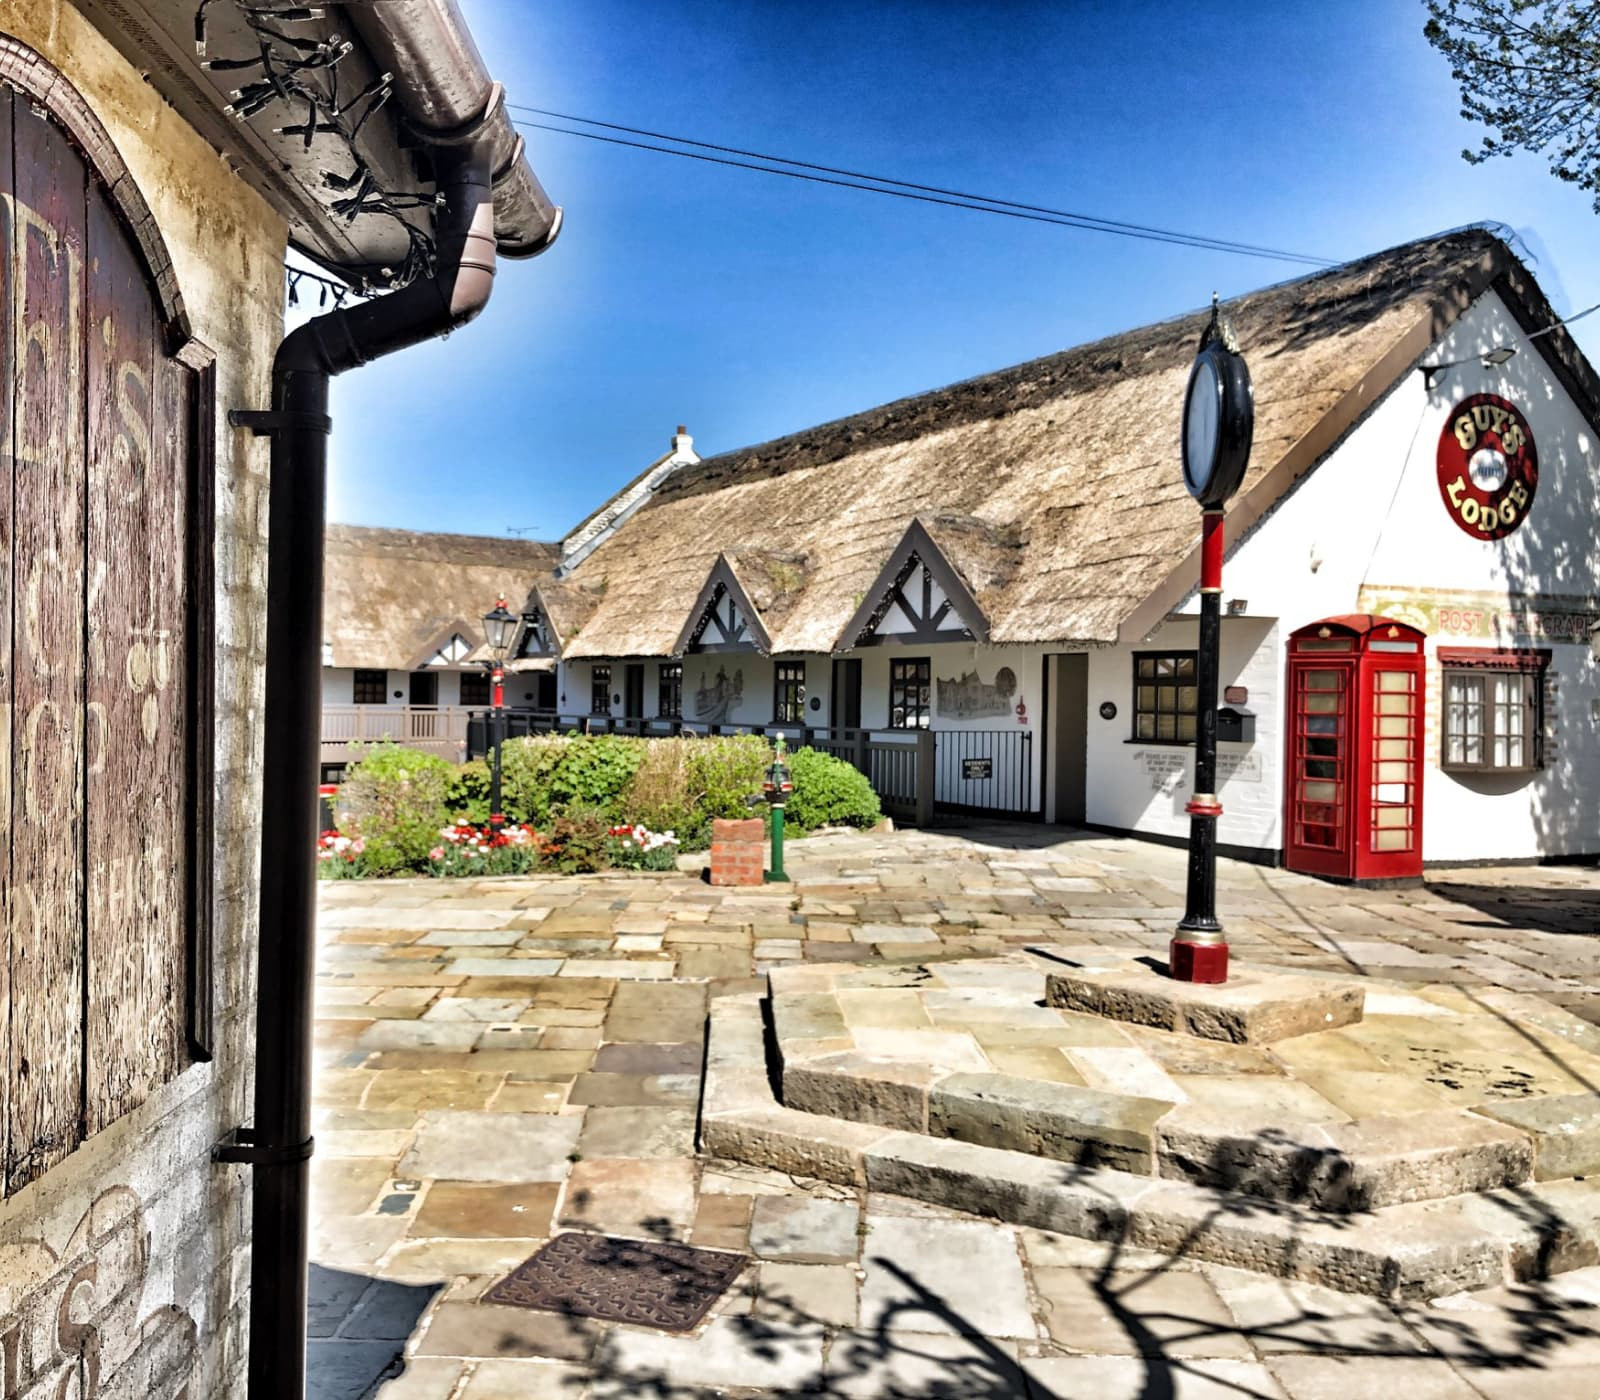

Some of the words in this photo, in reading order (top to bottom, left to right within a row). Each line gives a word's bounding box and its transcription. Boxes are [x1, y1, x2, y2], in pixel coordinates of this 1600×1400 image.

[1454, 404, 1527, 456] GUY'S
[1446, 475, 1529, 532] LODGE
[1439, 609, 1483, 633] POST
